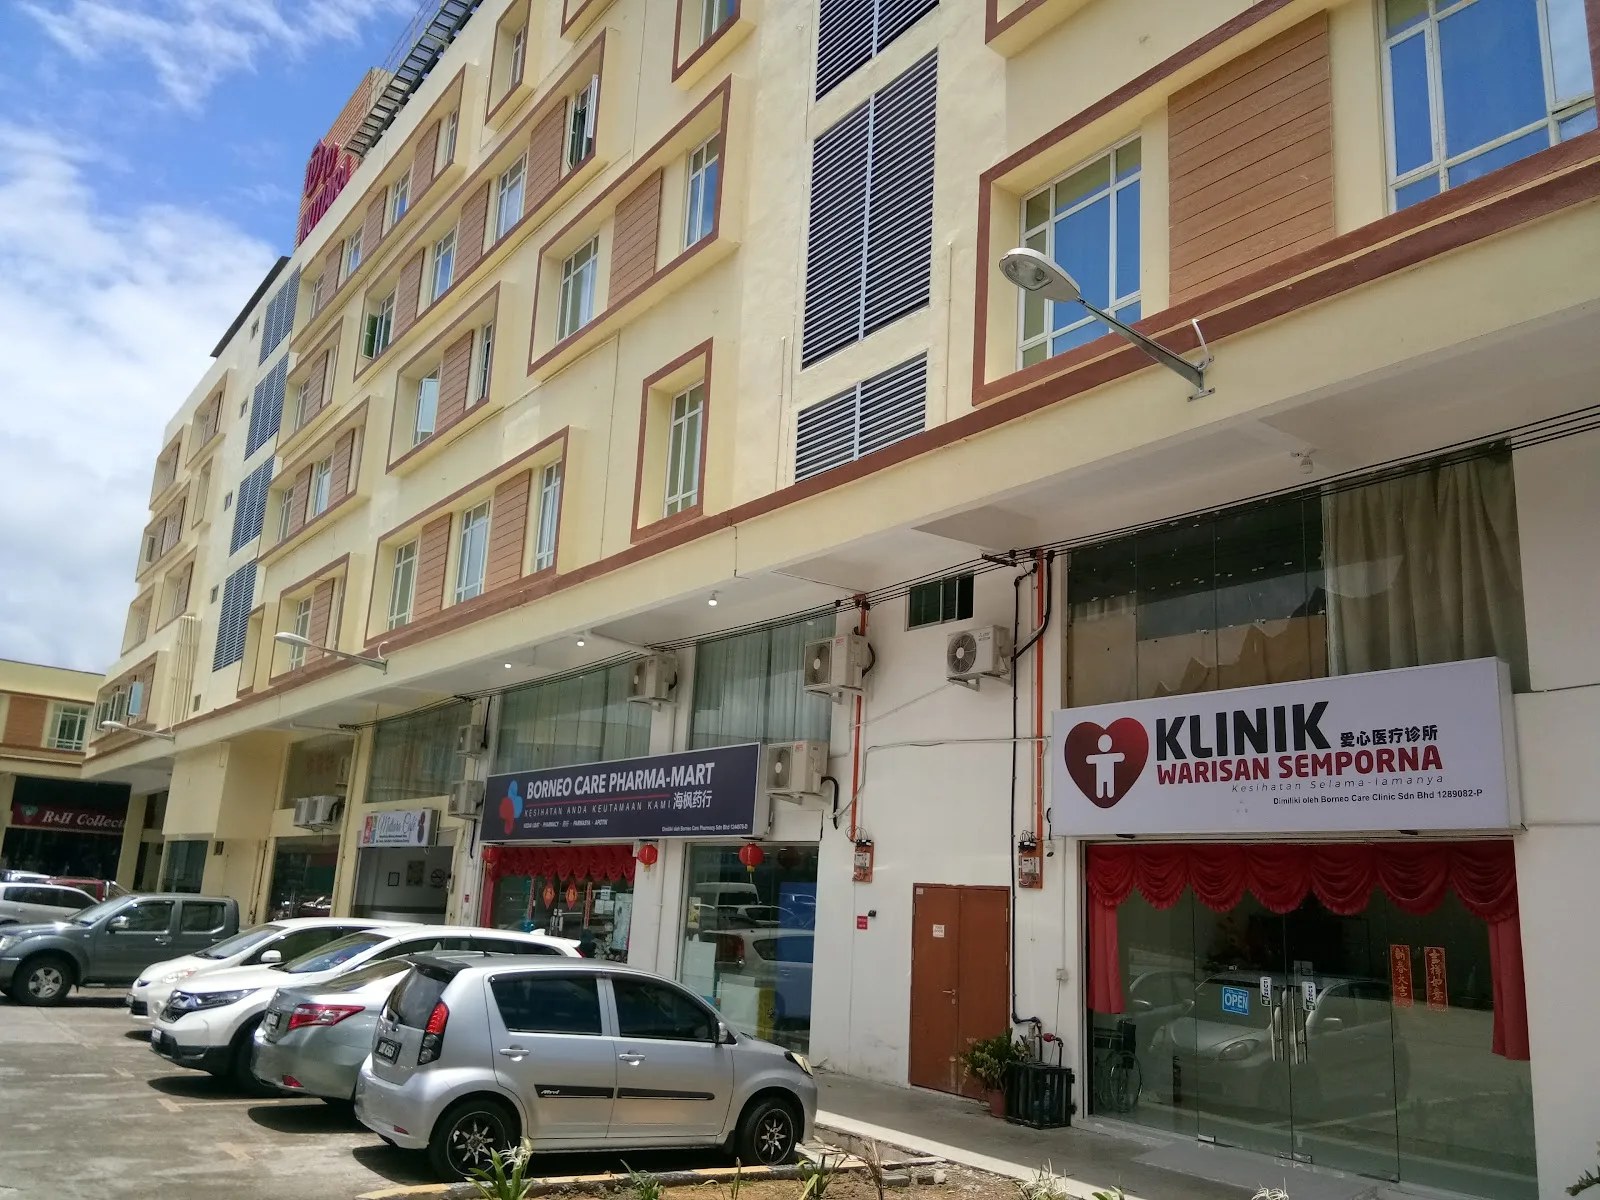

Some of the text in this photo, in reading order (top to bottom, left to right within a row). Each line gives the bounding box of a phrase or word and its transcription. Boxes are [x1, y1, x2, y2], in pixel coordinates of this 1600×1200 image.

[1156, 701, 1332, 761] KLINIK
[1340, 725, 1438, 748] 爱心医疗诊所
[1157, 745, 1443, 785] WARISAN SEMPORNA
[526, 762, 715, 799] BORNEO CARE PHARMA-MART
[1232, 775, 1443, 793] Kesihatan Selama-lamanya
[1273, 789, 1483, 805] Dimiliki oleh Borneo Care Clinic Sdn Bhd 1289082-P
[524, 800, 671, 818] KESIHATAN ANDA KEUTAMAAN KAMI
[1224, 992, 1248, 1010] OPEN
